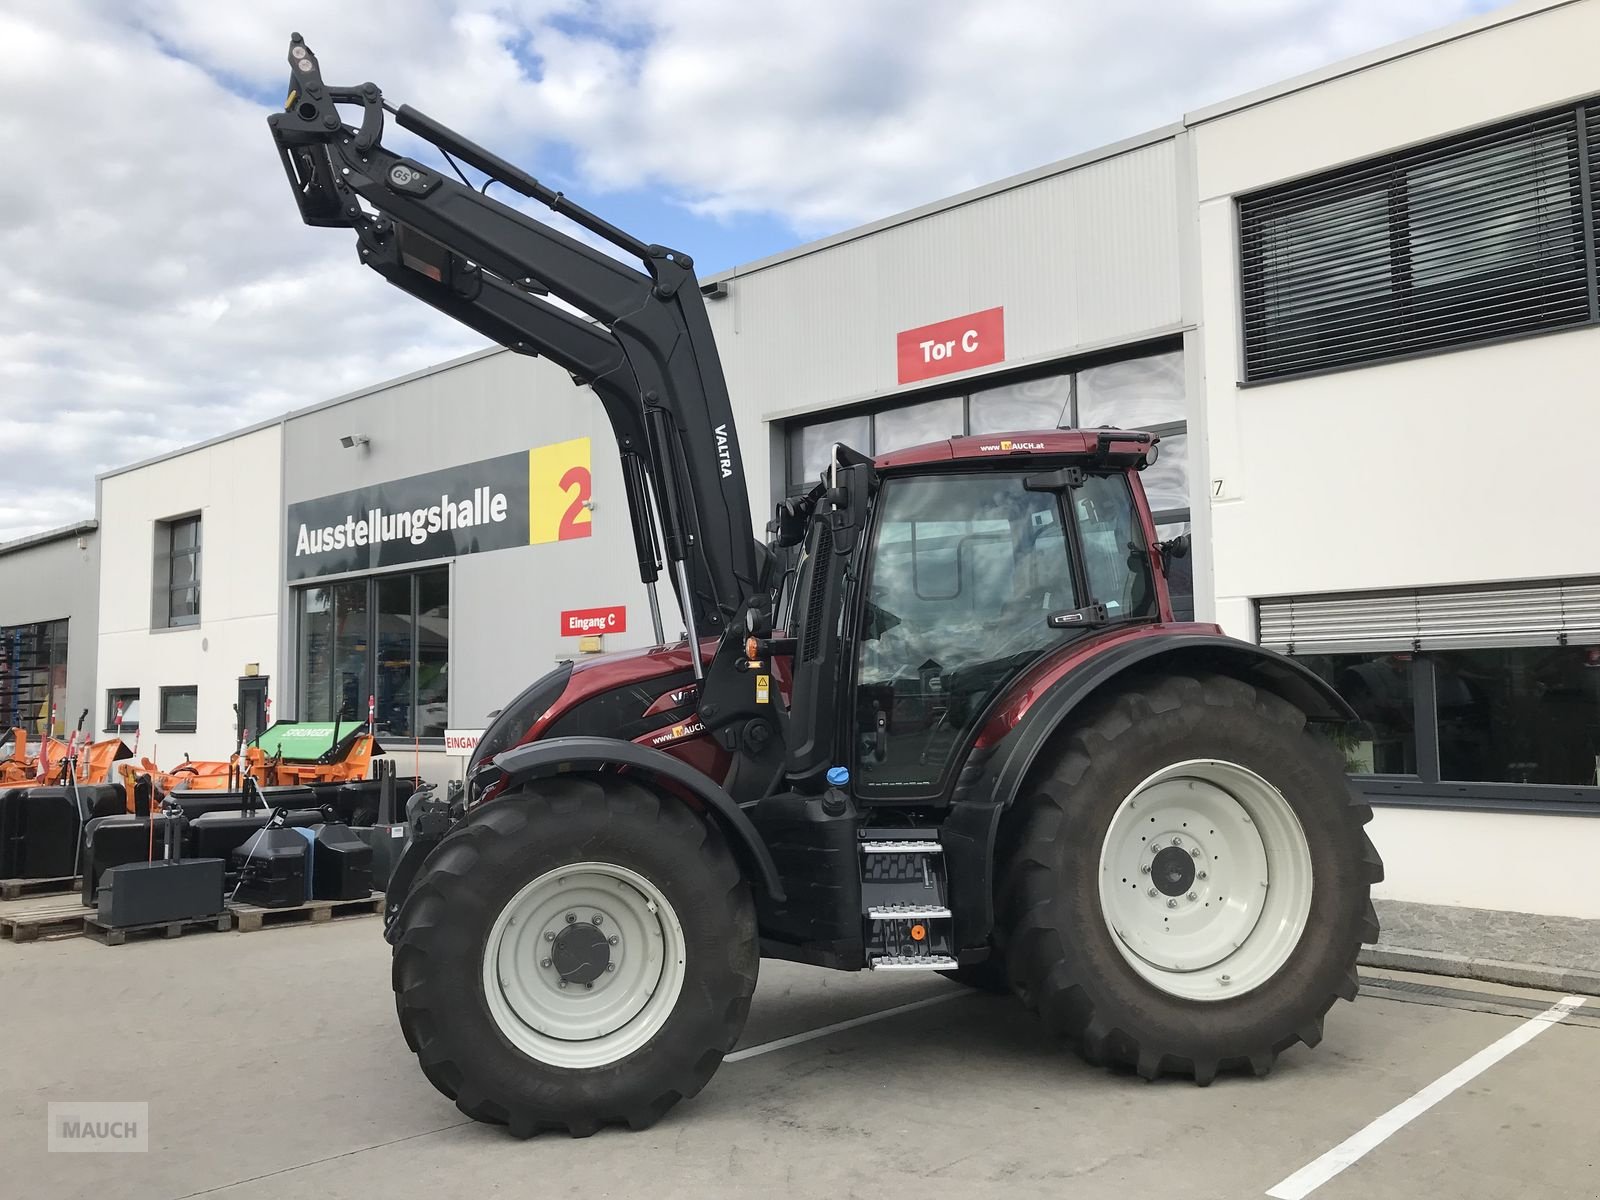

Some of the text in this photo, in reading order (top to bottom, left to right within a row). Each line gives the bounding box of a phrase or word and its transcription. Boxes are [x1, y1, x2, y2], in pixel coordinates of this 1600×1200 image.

[920, 329, 979, 363] Tor C
[715, 424, 732, 478] VALTRA
[1214, 480, 1223, 496] 7
[296, 466, 592, 556] Ausstellungshalle 2
[569, 613, 616, 631] Eingang C
[446, 737, 481, 749] EINGAN
